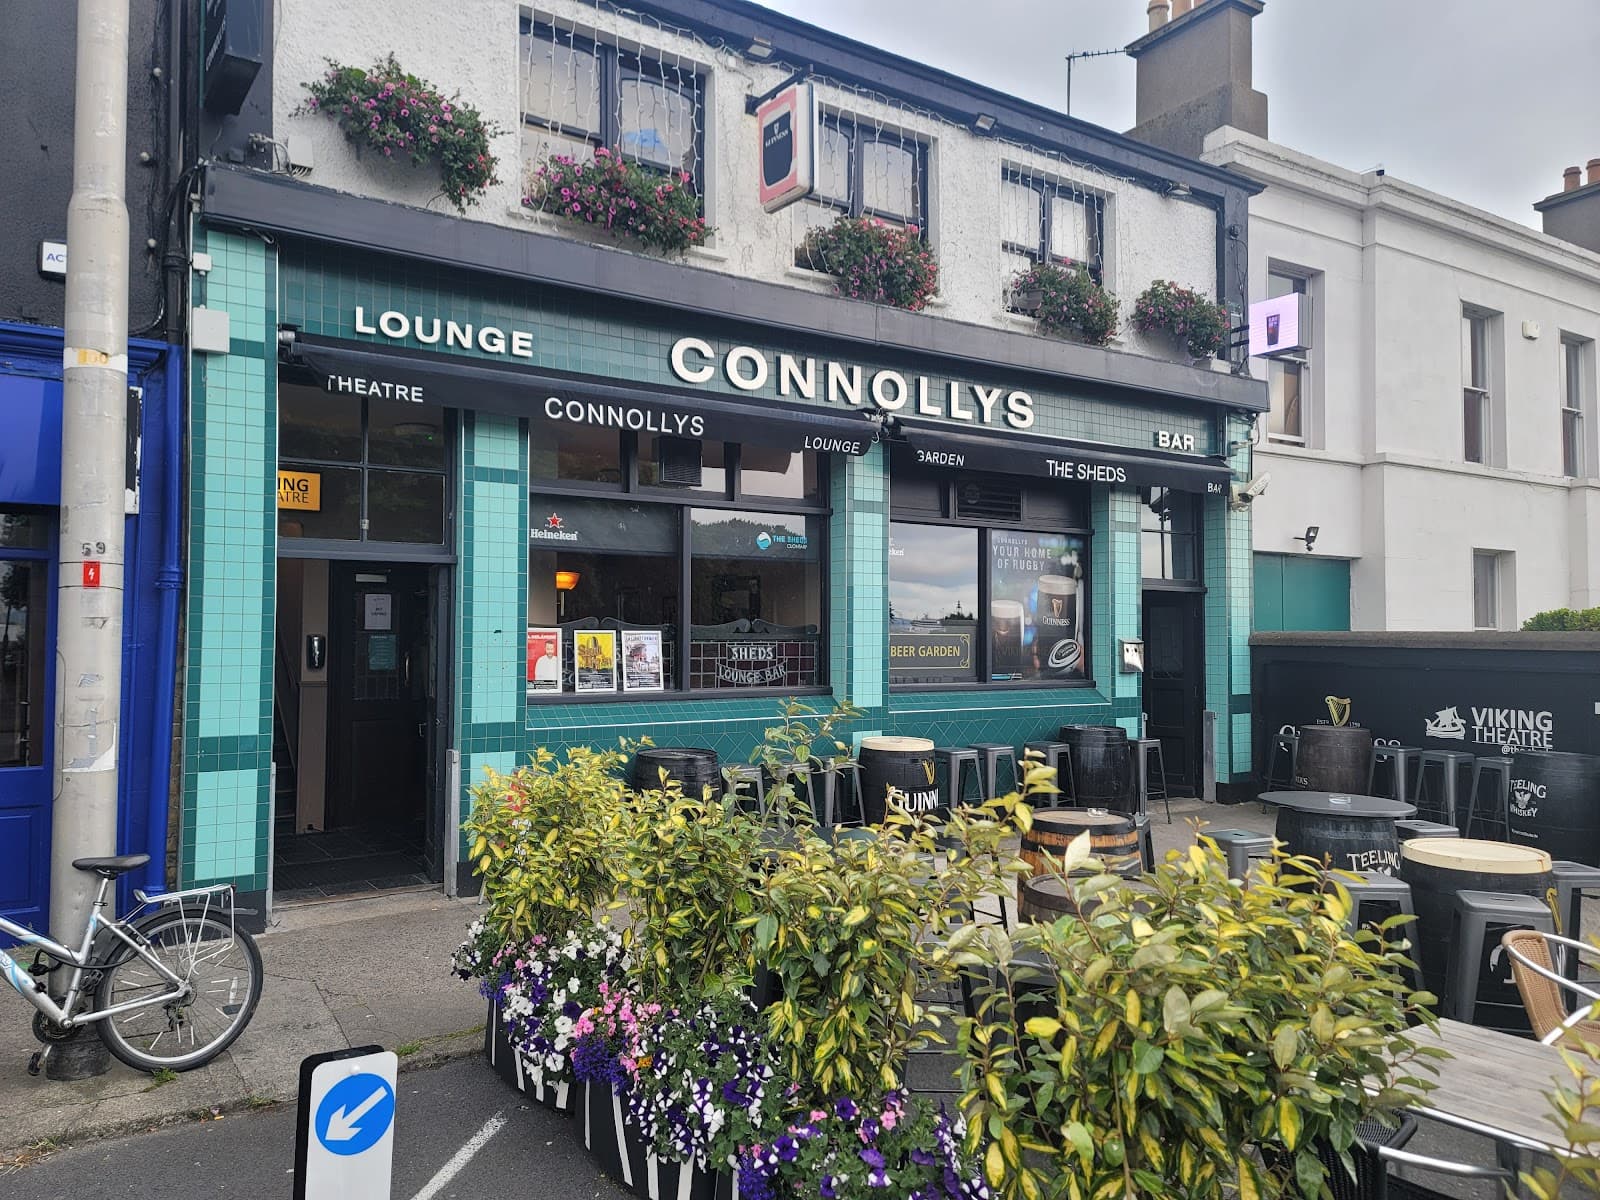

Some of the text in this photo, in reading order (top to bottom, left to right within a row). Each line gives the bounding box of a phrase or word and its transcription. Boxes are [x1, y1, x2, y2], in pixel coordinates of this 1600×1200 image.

[46, 253, 65, 263] AC
[355, 306, 534, 358] LOUNGE
[328, 375, 424, 403] THEATRE
[671, 337, 1035, 429] CONNOLLYS
[545, 397, 705, 436] CONNOLLYS
[804, 435, 860, 454] LOUNGE
[1158, 430, 1195, 451] BAR
[1046, 459, 1126, 483] THE SHEDS
[278, 477, 309, 492] ING
[1207, 482, 1222, 494] BAR
[278, 491, 309, 504] ATRE
[530, 528, 578, 541] Heineken
[993, 545, 1052, 559] YOUR HOME
[997, 558, 1045, 571] OF RUGBY
[731, 645, 775, 661] SHEDS
[890, 645, 961, 657] BEER GARDEN
[717, 663, 787, 684] LOUNGE BAR
[1471, 706, 1553, 732] VIKING
[1471, 725, 1553, 748] THEATRE
